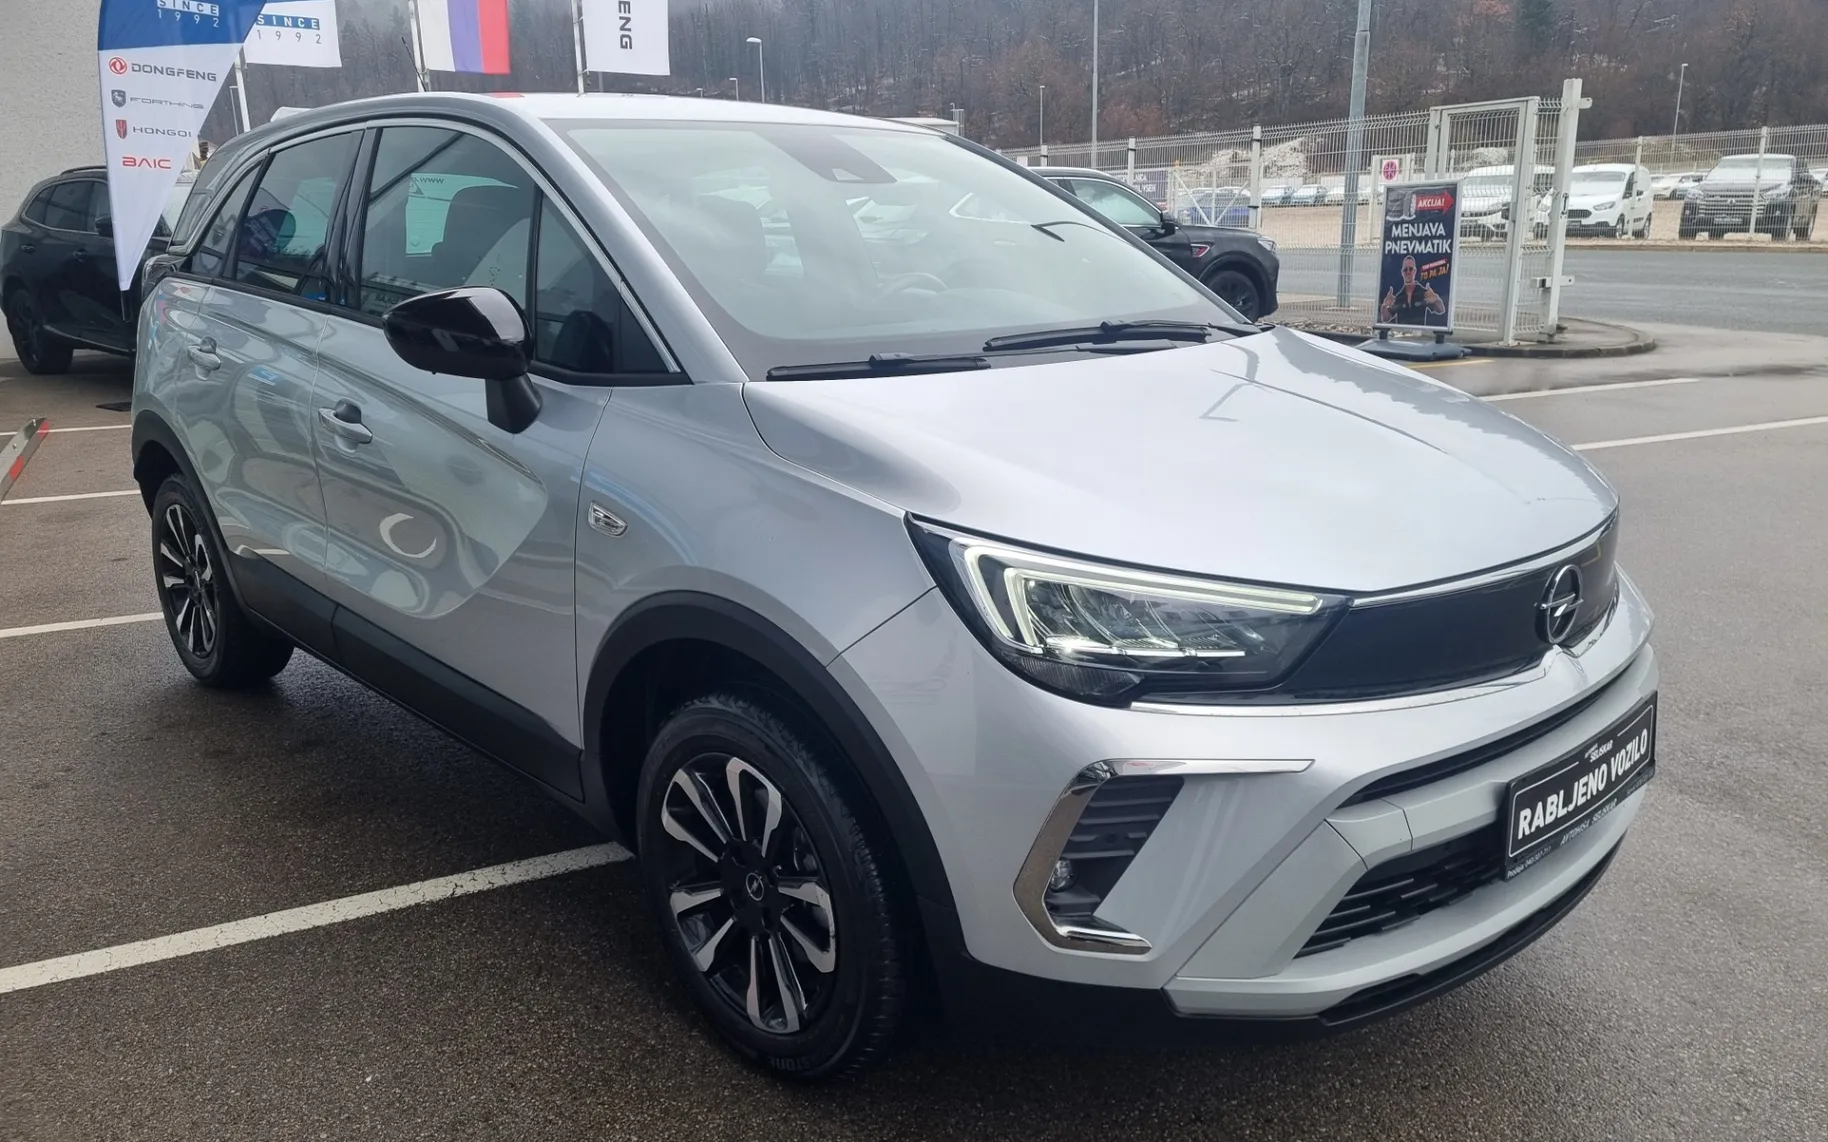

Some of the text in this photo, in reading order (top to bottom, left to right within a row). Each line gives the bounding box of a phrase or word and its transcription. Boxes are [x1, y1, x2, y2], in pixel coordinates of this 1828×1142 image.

[157, 0, 218, 15] SINCE
[157, 9, 219, 28] 1992
[256, 14, 319, 29] SINCE
[256, 29, 322, 45] 1992
[131, 63, 217, 82] DONGFENG
[130, 96, 204, 110] FORTHING
[122, 156, 171, 169] BAIC
[1391, 222, 1446, 238] MENJAVA
[1385, 240, 1452, 255] PNEVMATIK
[1517, 763, 1609, 840] RABLJENO
[1610, 728, 1648, 782] VOZILO
